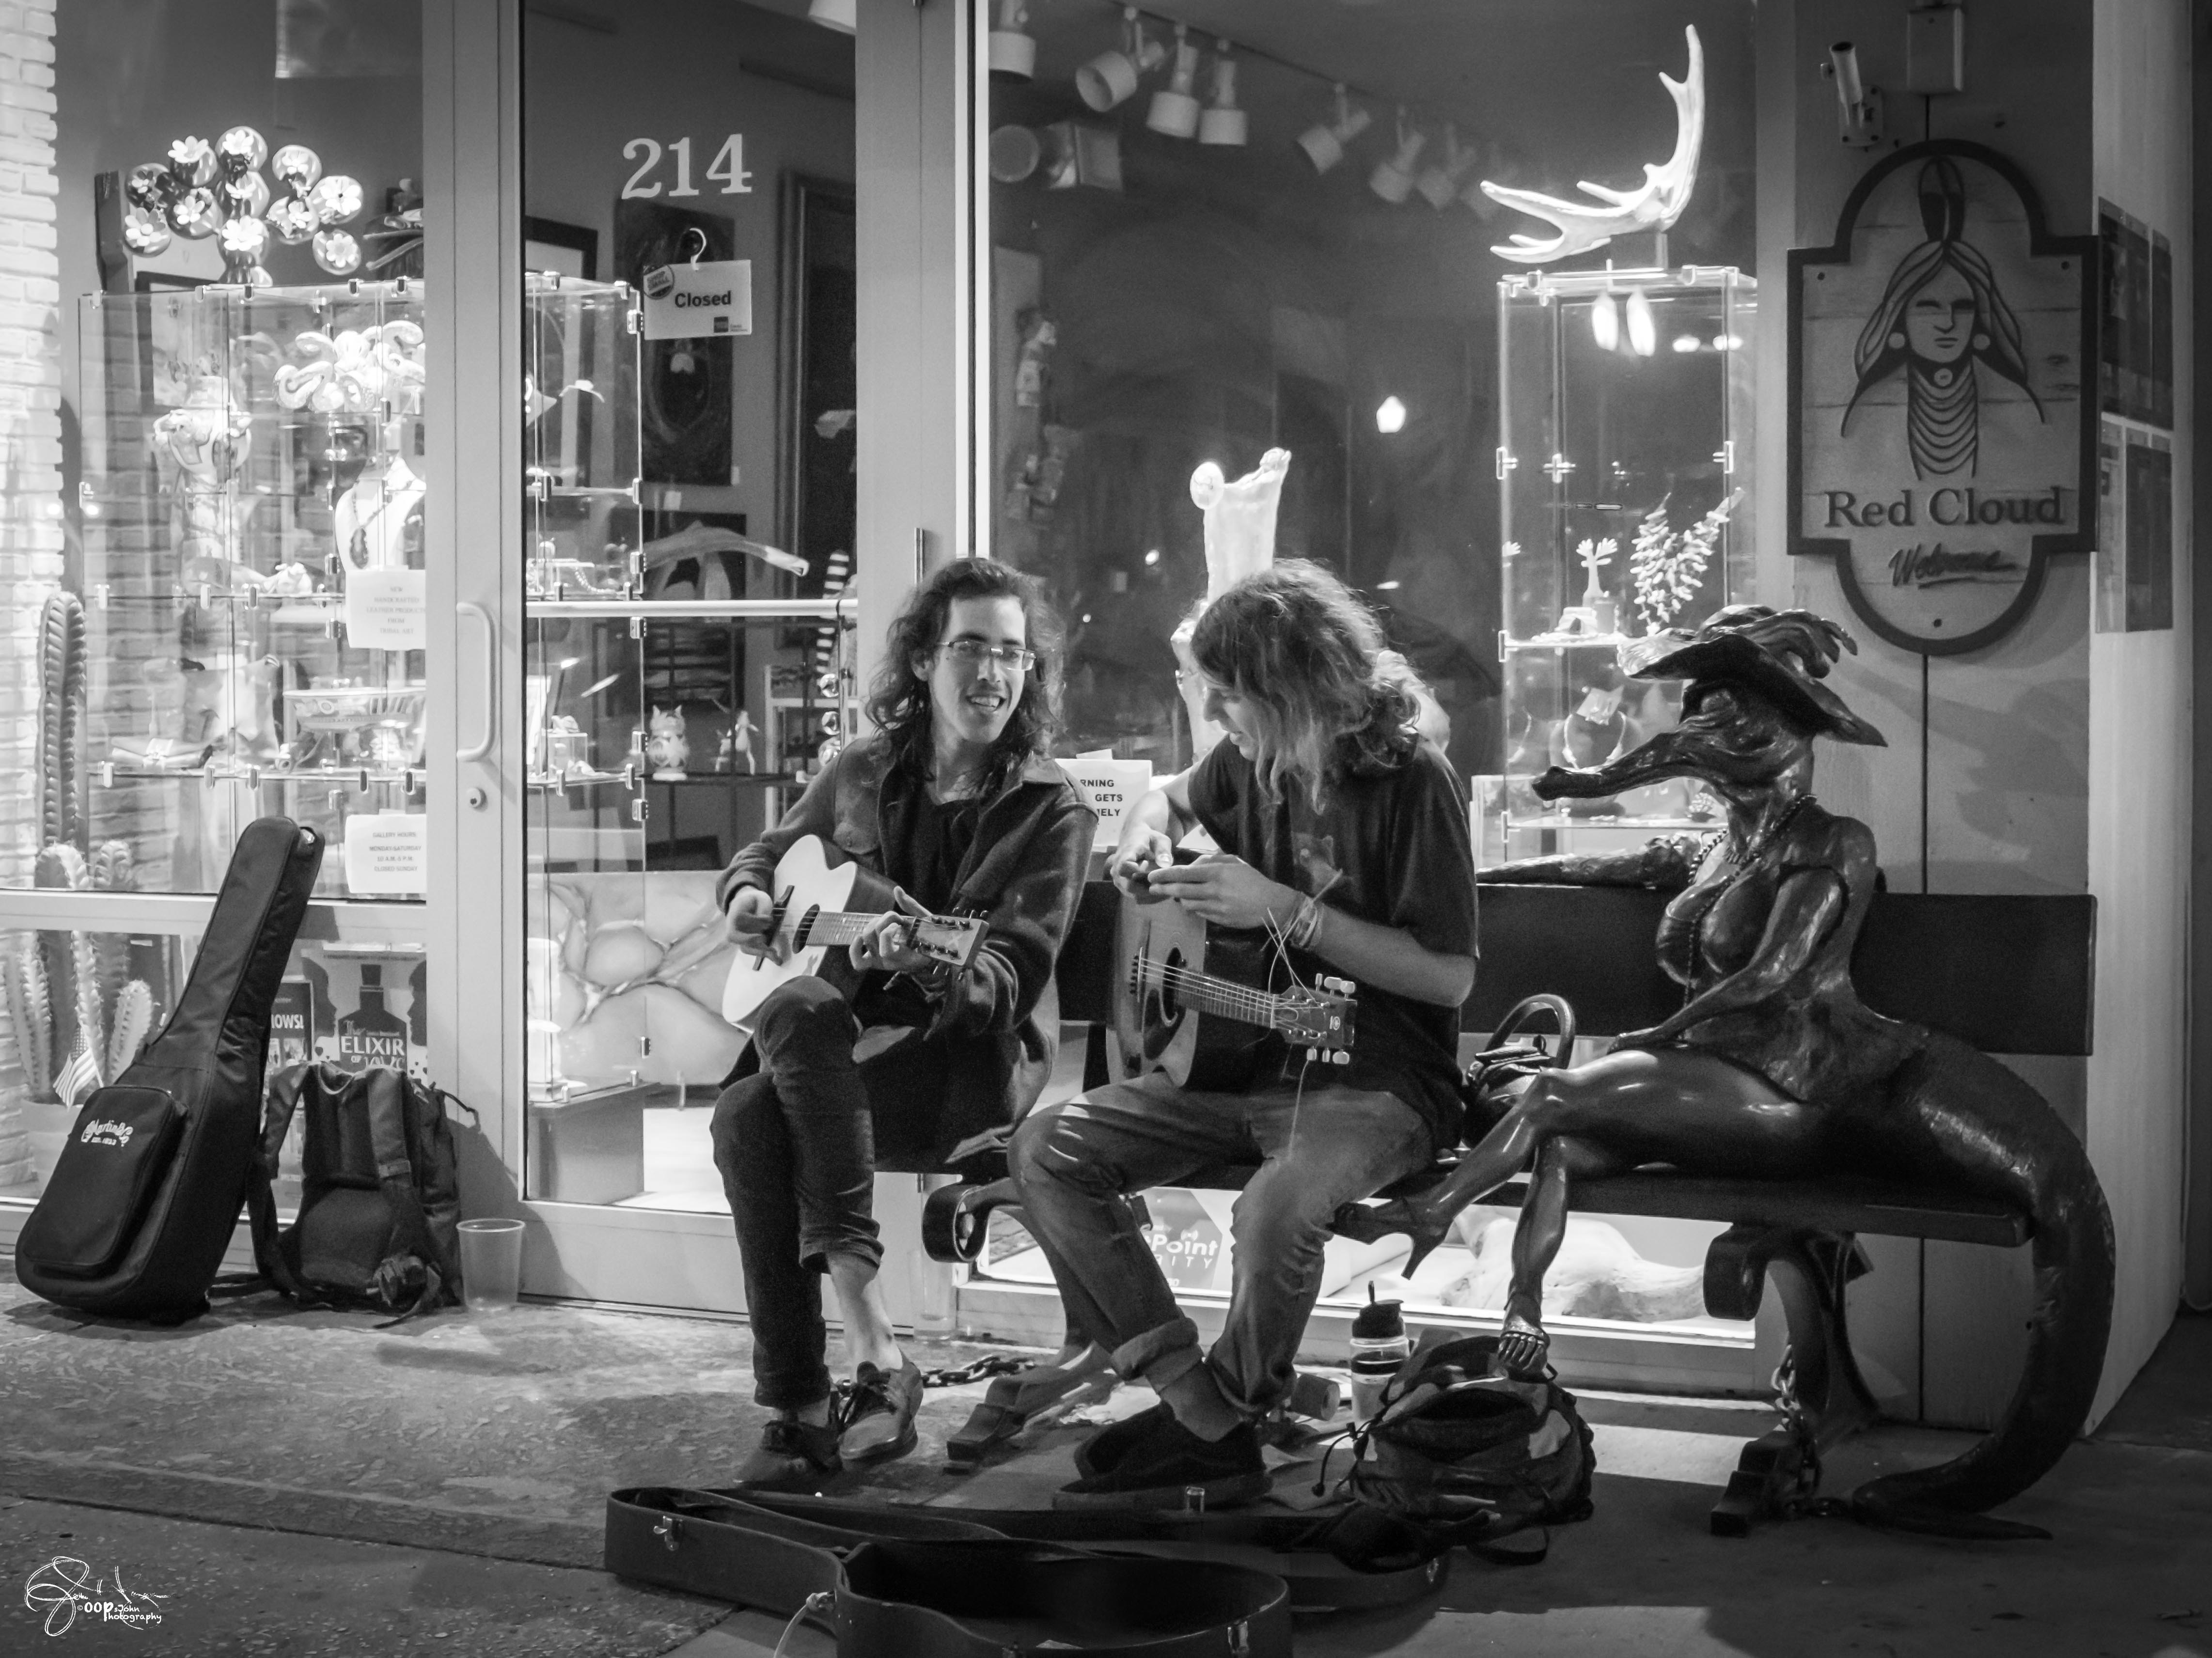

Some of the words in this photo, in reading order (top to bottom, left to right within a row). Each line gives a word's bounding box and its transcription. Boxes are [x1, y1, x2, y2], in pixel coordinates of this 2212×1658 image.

[622, 134, 752, 199] 214
[675, 290, 731, 308] Closed
[1824, 489, 1915, 527] Red
[1929, 486, 2065, 526] Cloud
[341, 1035, 405, 1056] ELIXIR
[1144, 1234, 1218, 1256] Point
